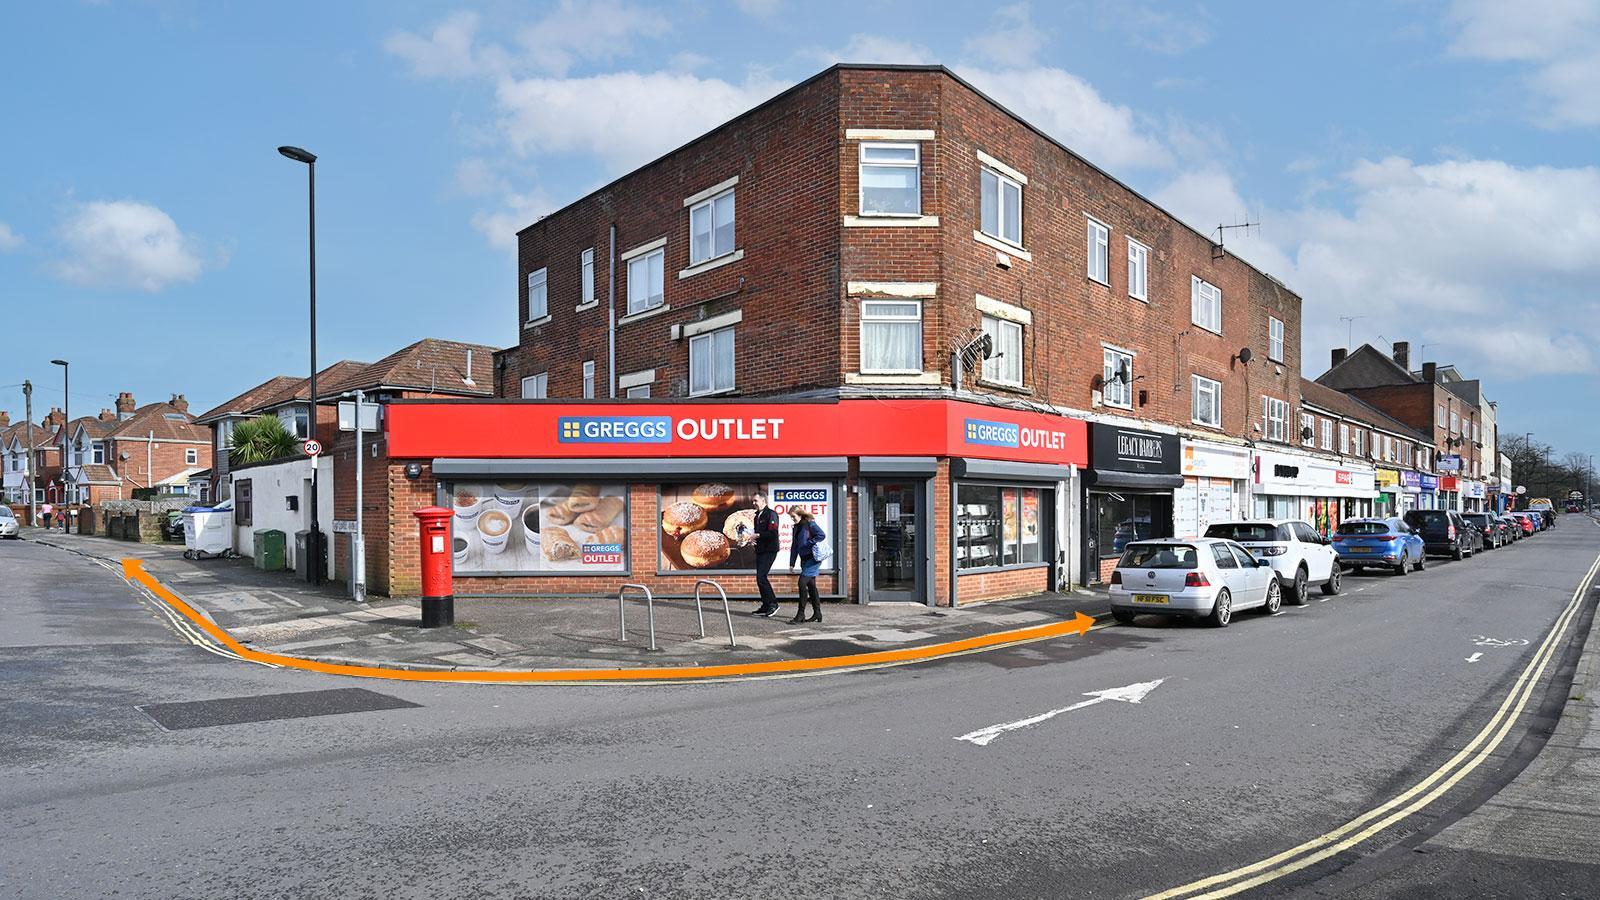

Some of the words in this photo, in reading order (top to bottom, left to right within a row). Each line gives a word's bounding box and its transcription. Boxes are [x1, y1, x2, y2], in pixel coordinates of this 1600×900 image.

[584, 421, 666, 438] GREGGS
[676, 418, 784, 440] OUTLET
[978, 425, 1018, 443] GREGGS
[1020, 427, 1066, 449] OUTLET
[306, 443, 318, 451] 20
[785, 491, 825, 500] GREGGS
[584, 554, 620, 563] OUTLET
